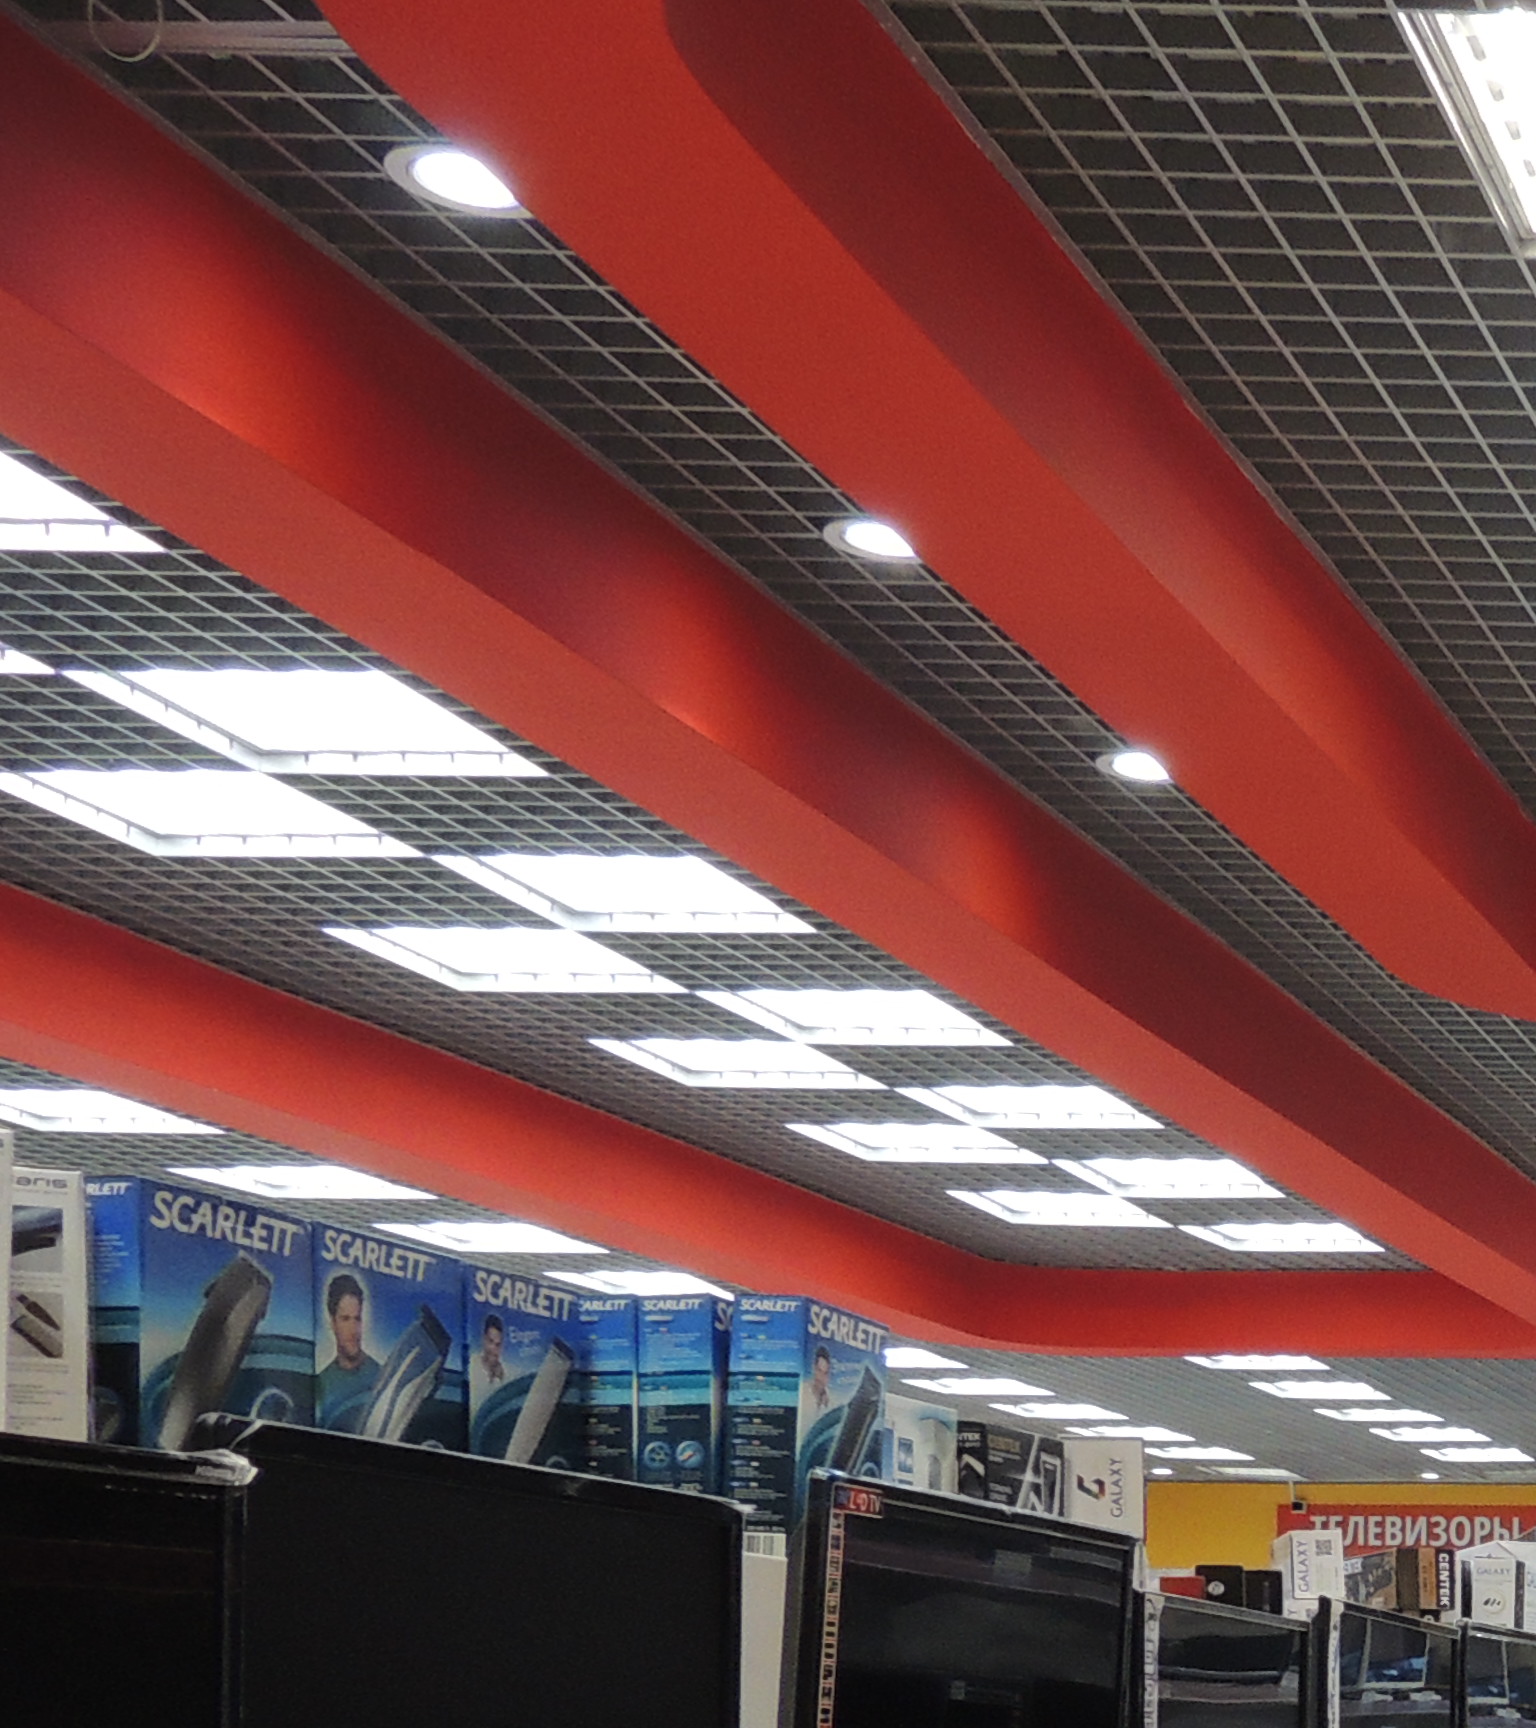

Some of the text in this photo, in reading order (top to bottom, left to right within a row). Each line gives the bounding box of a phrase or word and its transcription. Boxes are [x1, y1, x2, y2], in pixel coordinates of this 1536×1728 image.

[16, 1176, 68, 1189] aris
[86, 1182, 131, 1197] RLETT
[149, 1190, 300, 1258] SCARLETT
[321, 1229, 436, 1284] SCARLETT
[474, 1270, 576, 1322] SCARLETT
[579, 1299, 628, 1312] ARLETT
[642, 1299, 701, 1312] SCARLETT
[739, 1299, 798, 1312] SCARLETT
[808, 1304, 887, 1354] SCARLETT
[958, 1431, 982, 1441] NTEK
[1110, 1457, 1125, 1518] GALAXY
[1296, 1539, 1310, 1593] GALAXY
[1438, 1552, 1450, 1608] CENTEK
[1476, 1565, 1512, 1577] GALAXY
